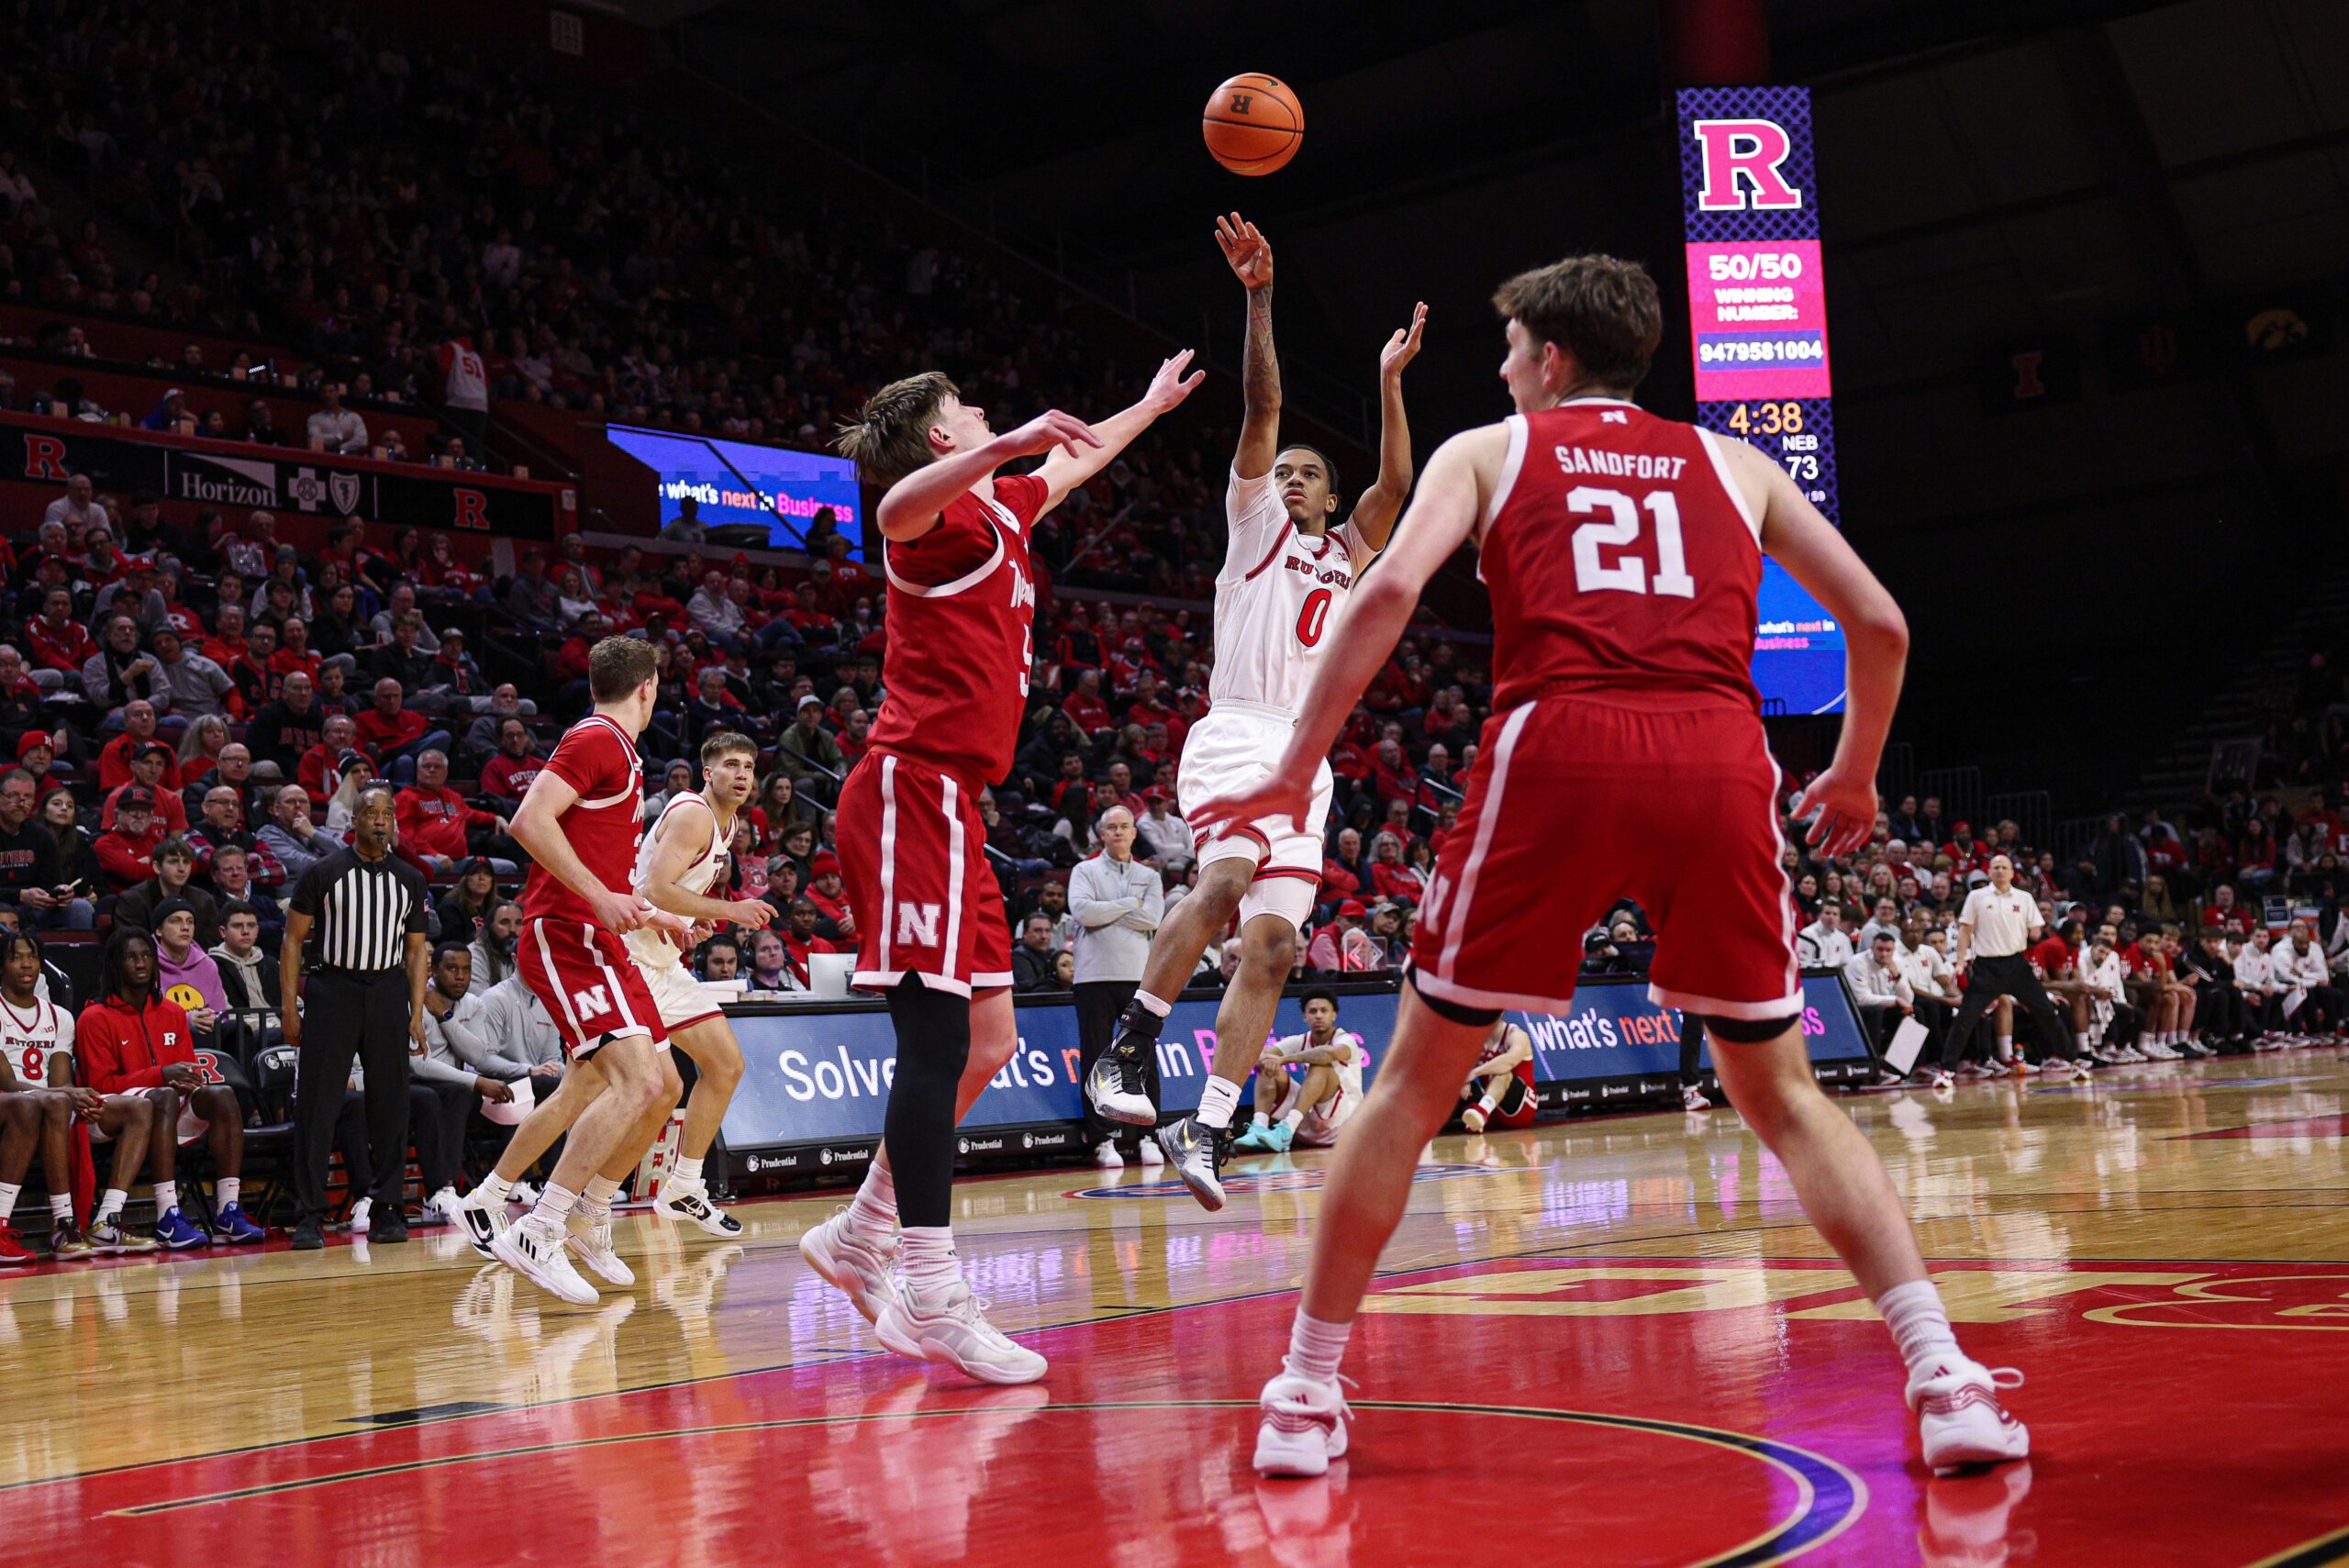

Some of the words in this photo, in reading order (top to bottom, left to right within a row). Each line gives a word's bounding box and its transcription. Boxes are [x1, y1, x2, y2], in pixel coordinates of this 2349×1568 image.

[1230, 95, 1252, 115] R
[1693, 118, 1802, 211] R
[1709, 252, 1802, 281] 50/50
[1729, 402, 1803, 435] 4:38
[24, 433, 70, 482] R
[1782, 435, 1819, 451] NEB
[1555, 446, 1687, 480] SANDFORT
[1785, 455, 1819, 480] 73
[182, 472, 278, 508] Horizon
[722, 490, 757, 510] next
[453, 487, 491, 530] R
[1566, 485, 1695, 599] 21
[1296, 588, 1332, 647] 0
[897, 901, 941, 948] N
[573, 984, 612, 1023] N
[163, 1032, 176, 1047] R
[1529, 1007, 1619, 1052] what's
[1619, 1009, 1681, 1046] next
[22, 1048, 44, 1081] 8
[194, 1052, 226, 1084] R
[834, 1149, 869, 1162] Prudential
[971, 1139, 1003, 1151] Prudential
[1034, 1134, 1065, 1146] Prudential
[761, 1155, 797, 1170] Prudential
